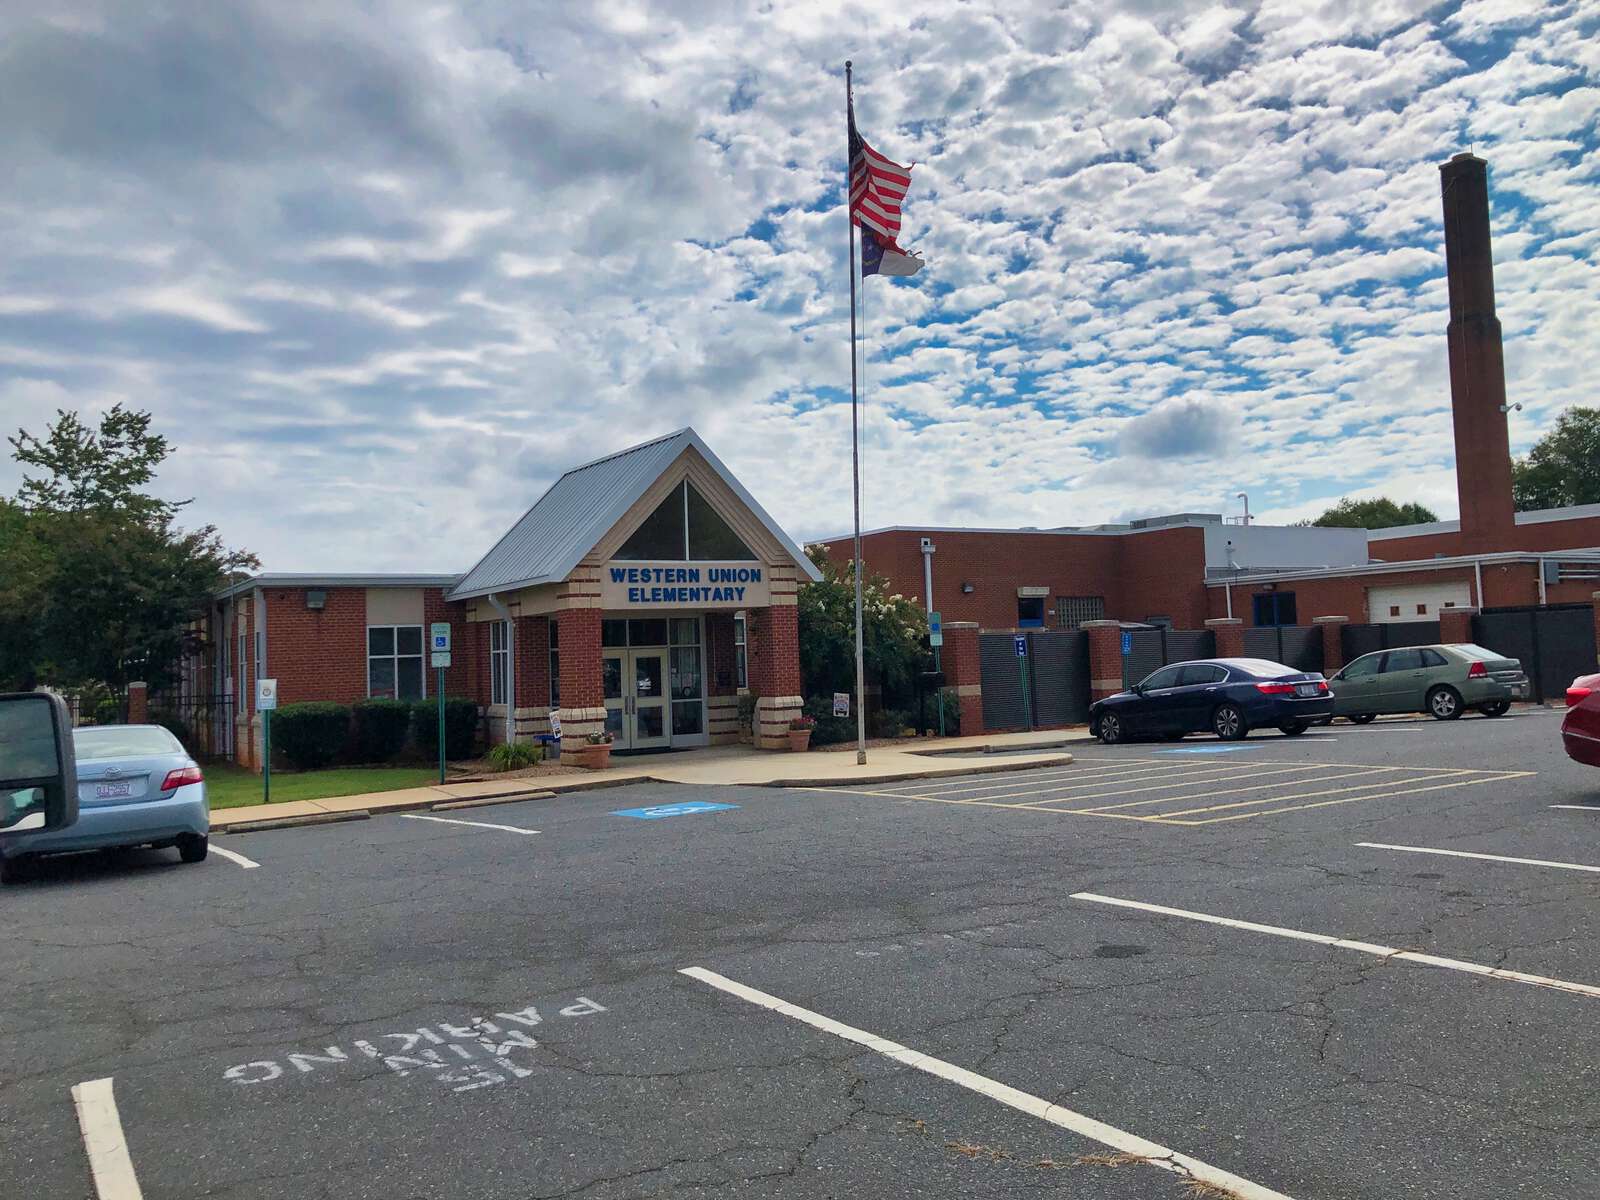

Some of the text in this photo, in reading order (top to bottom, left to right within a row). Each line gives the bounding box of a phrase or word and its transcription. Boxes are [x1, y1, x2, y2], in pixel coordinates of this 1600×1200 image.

[609, 568, 762, 583] WESTERN UNION
[628, 587, 746, 602] ELEMENTARY
[222, 996, 608, 1085] PARKING
